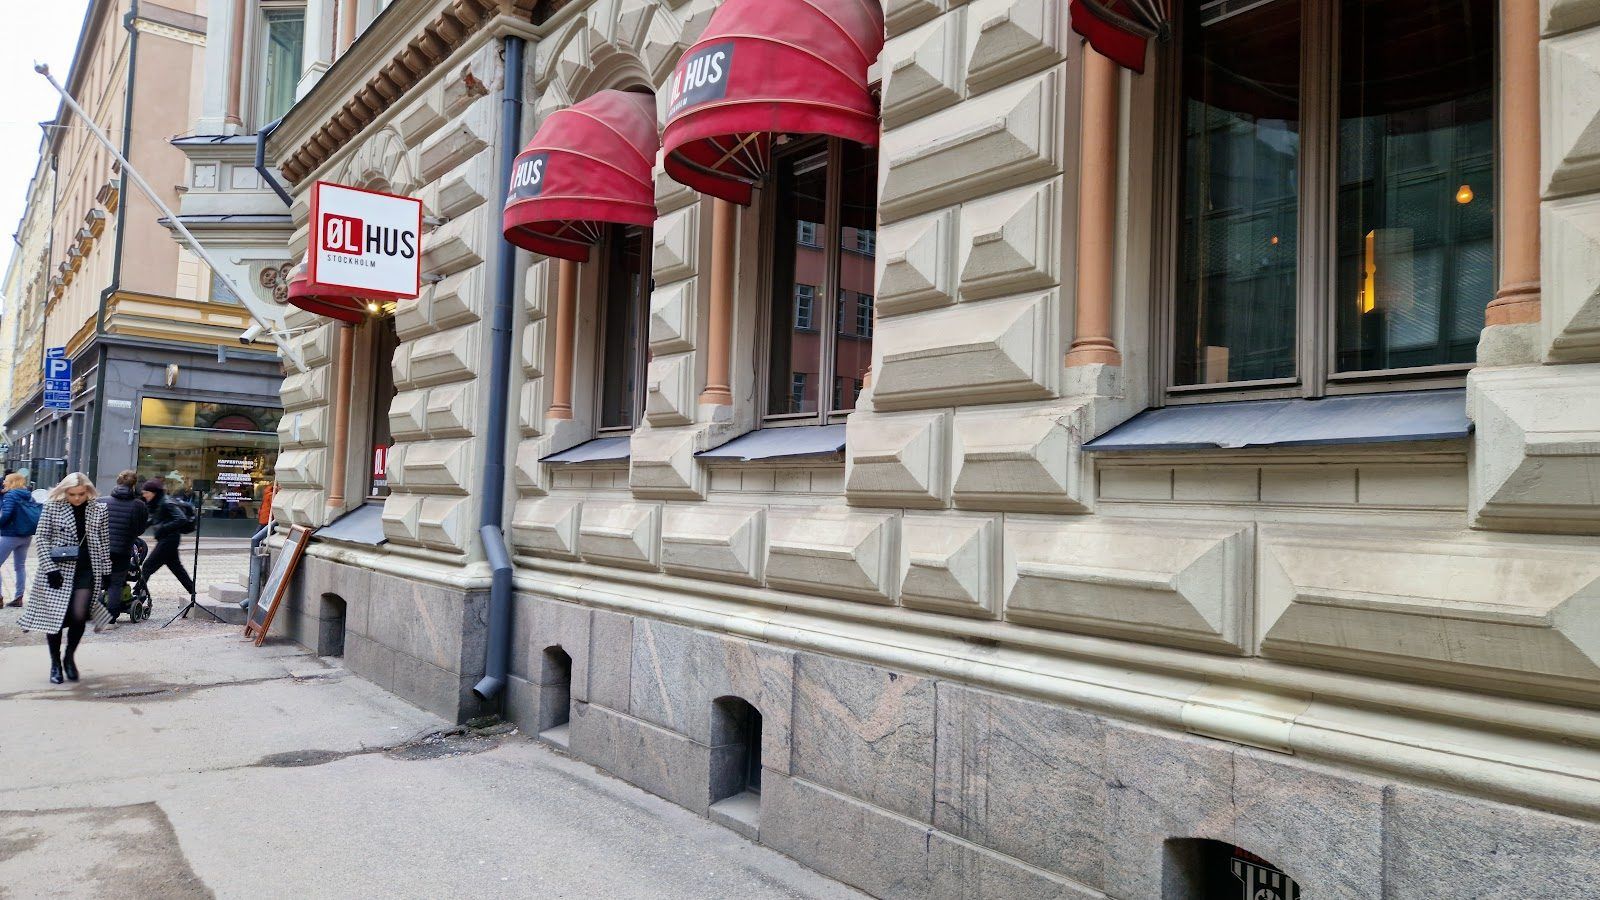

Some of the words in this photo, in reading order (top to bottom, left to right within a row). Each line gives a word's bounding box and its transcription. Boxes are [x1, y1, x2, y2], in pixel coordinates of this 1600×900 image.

[683, 52, 725, 93] HUS
[514, 159, 543, 189] HUS
[366, 224, 415, 259] HUS
[327, 254, 376, 268] STOCKHOLM
[50, 359, 68, 378] P
